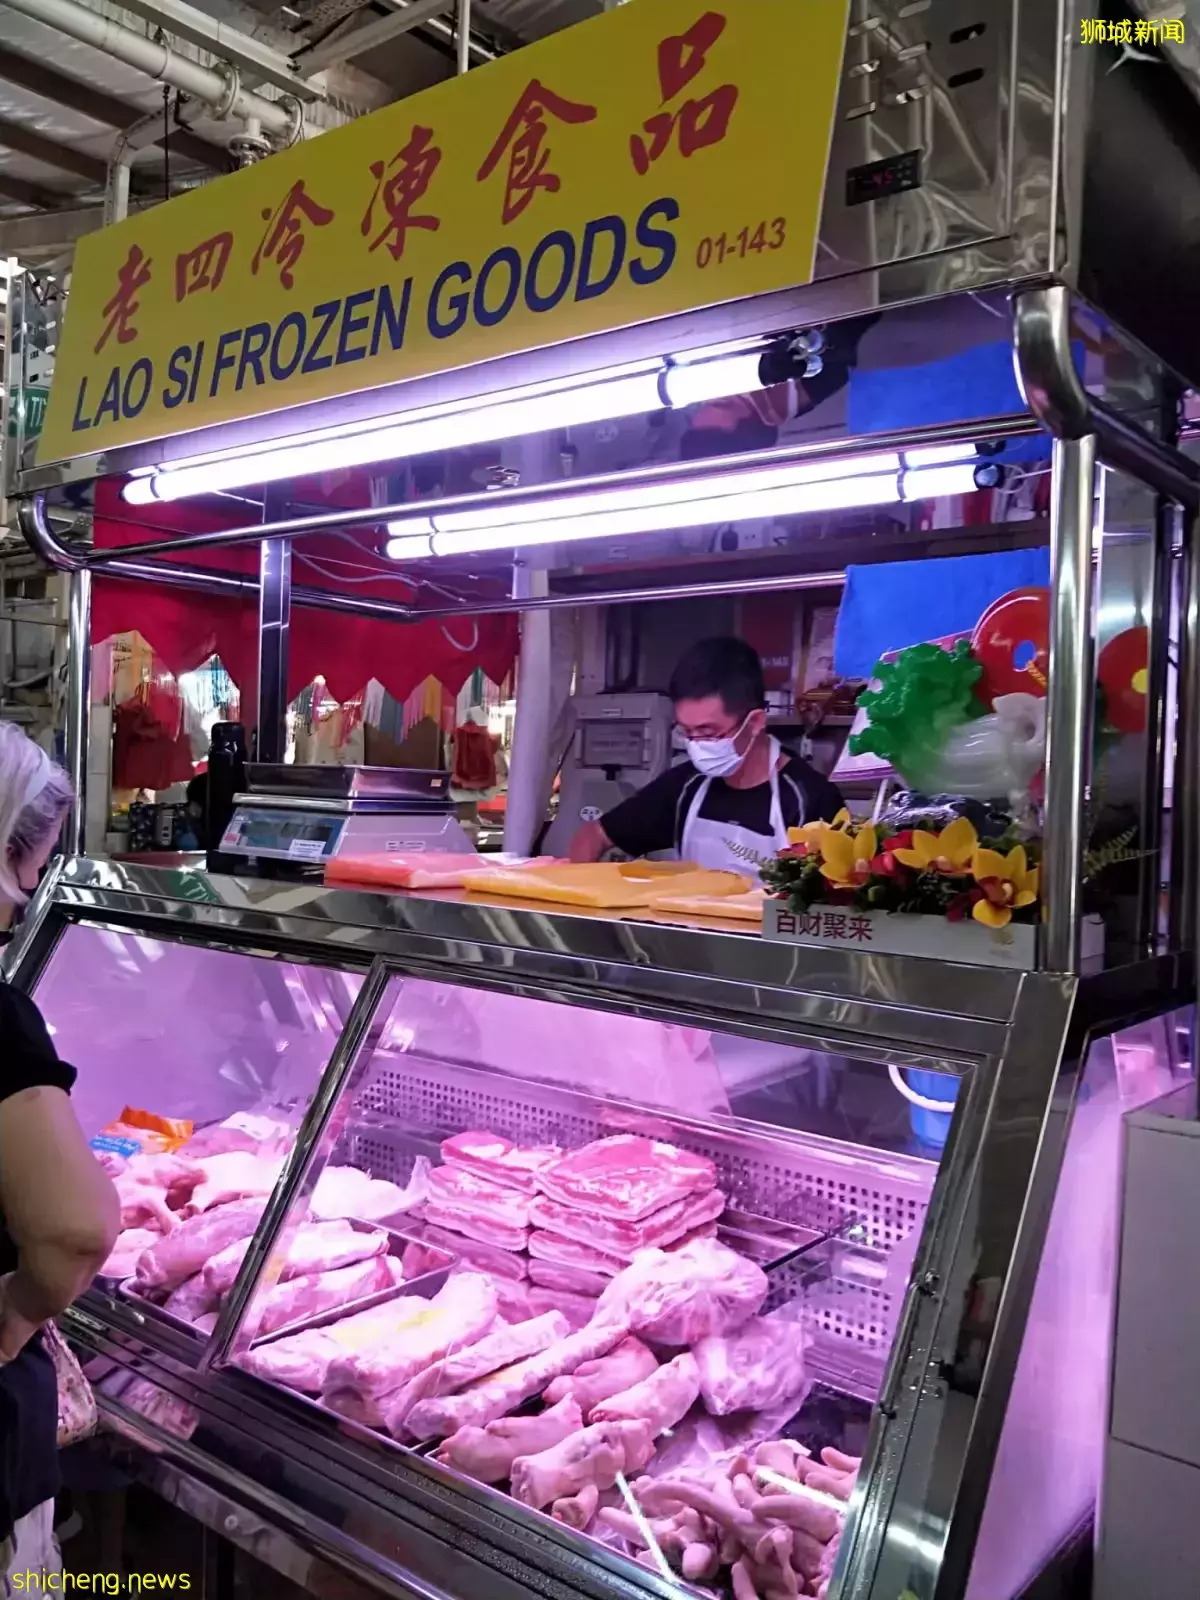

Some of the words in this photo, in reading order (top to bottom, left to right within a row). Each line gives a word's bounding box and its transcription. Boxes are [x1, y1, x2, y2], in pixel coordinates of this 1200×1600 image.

[696, 217, 786, 269] 01-143
[72, 357, 153, 432] LAO
[163, 341, 204, 409] SI
[209, 277, 413, 398] FROZEN
[426, 197, 680, 339] GOODS
[775, 908, 873, 942] 百财聚来
